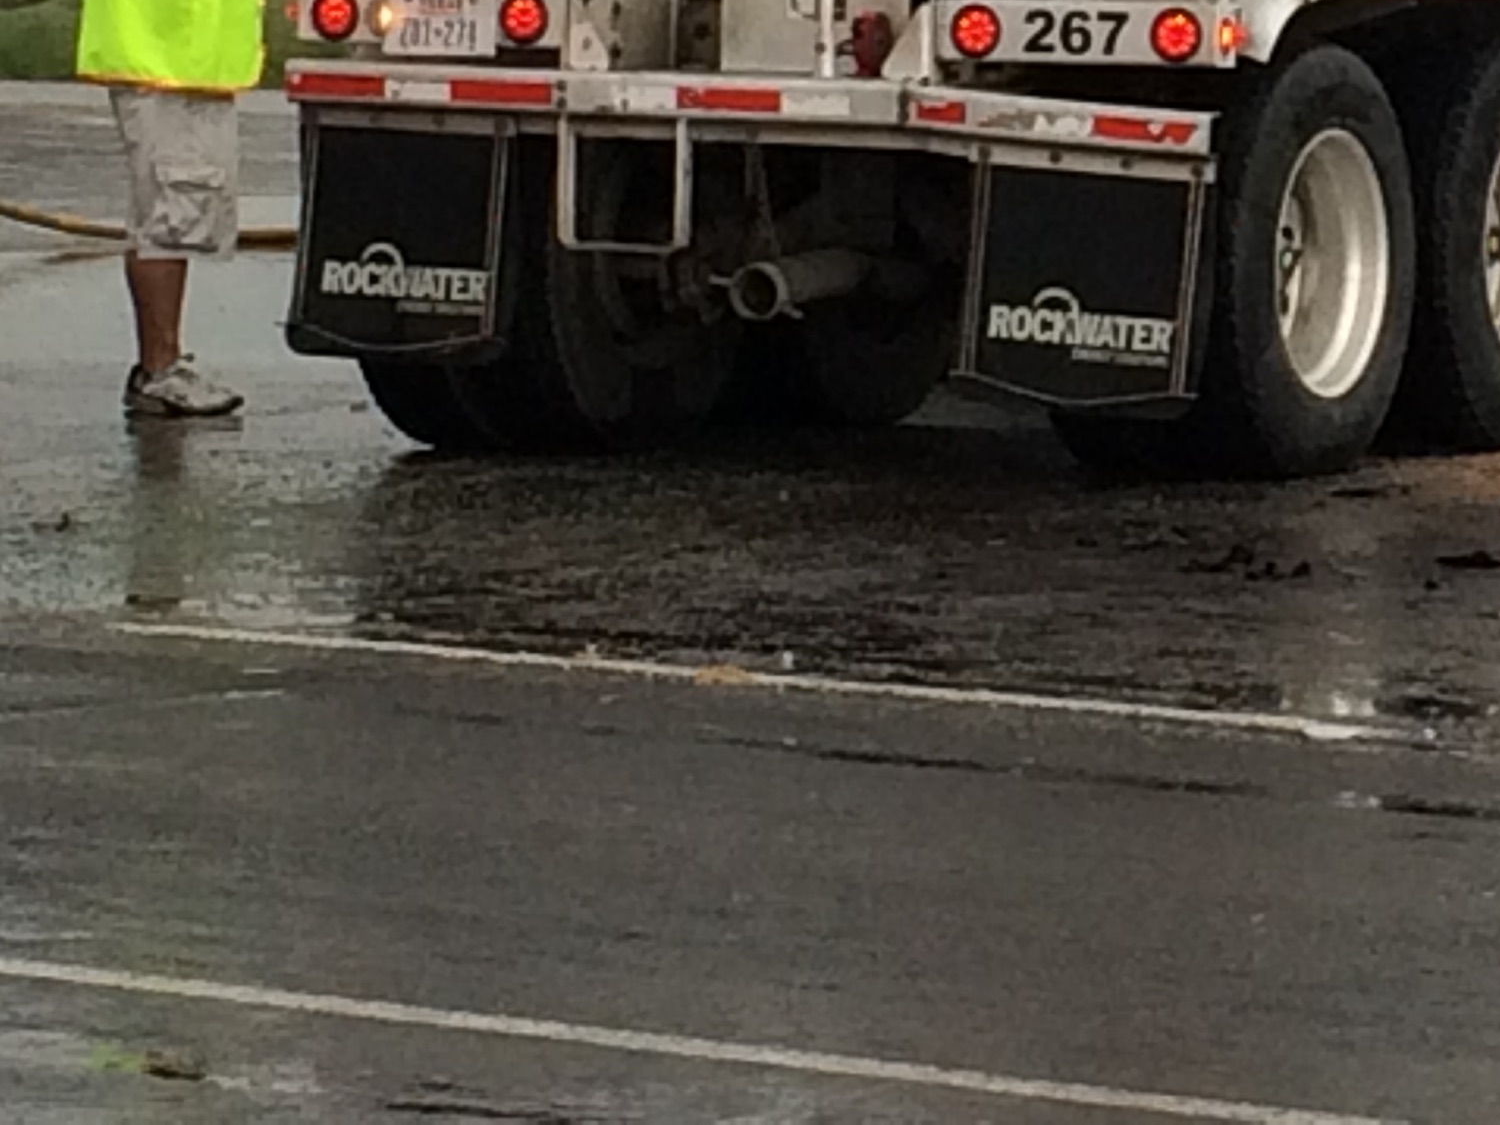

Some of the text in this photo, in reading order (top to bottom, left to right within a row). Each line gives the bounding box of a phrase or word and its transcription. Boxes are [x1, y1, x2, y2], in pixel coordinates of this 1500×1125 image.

[1023, 10, 1129, 56] 267
[321, 259, 487, 302] ROCKWATER
[987, 304, 1173, 353] ROCKWATER
